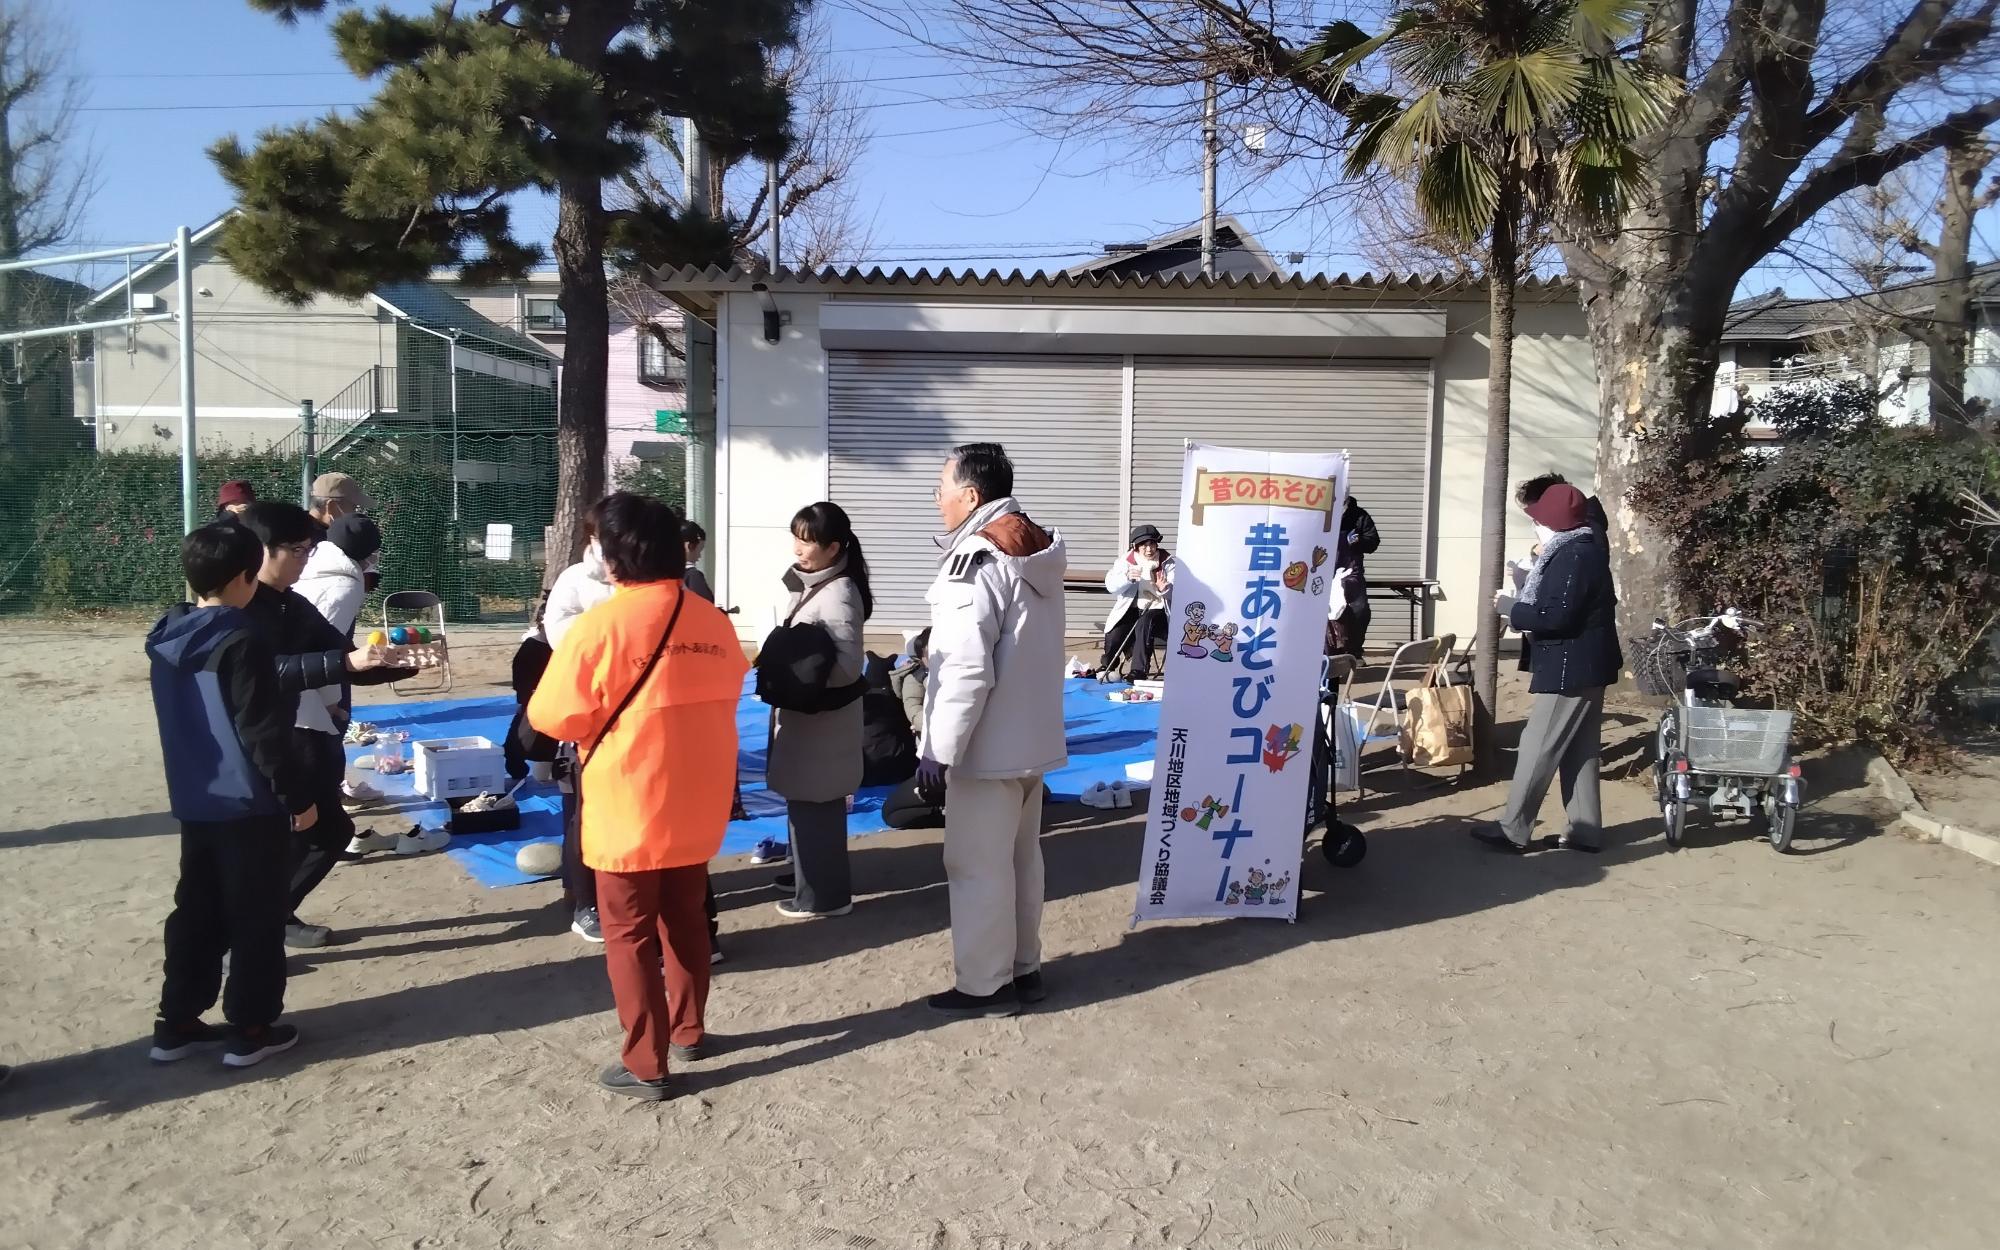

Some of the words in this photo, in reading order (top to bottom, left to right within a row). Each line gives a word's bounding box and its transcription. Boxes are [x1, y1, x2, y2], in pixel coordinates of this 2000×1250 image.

[1209, 477, 1327, 506] 昔のあそび
[1212, 522, 1290, 902] 昔あそびコーナー
[1150, 727, 1188, 905] 天川地区地域づくり協議会
